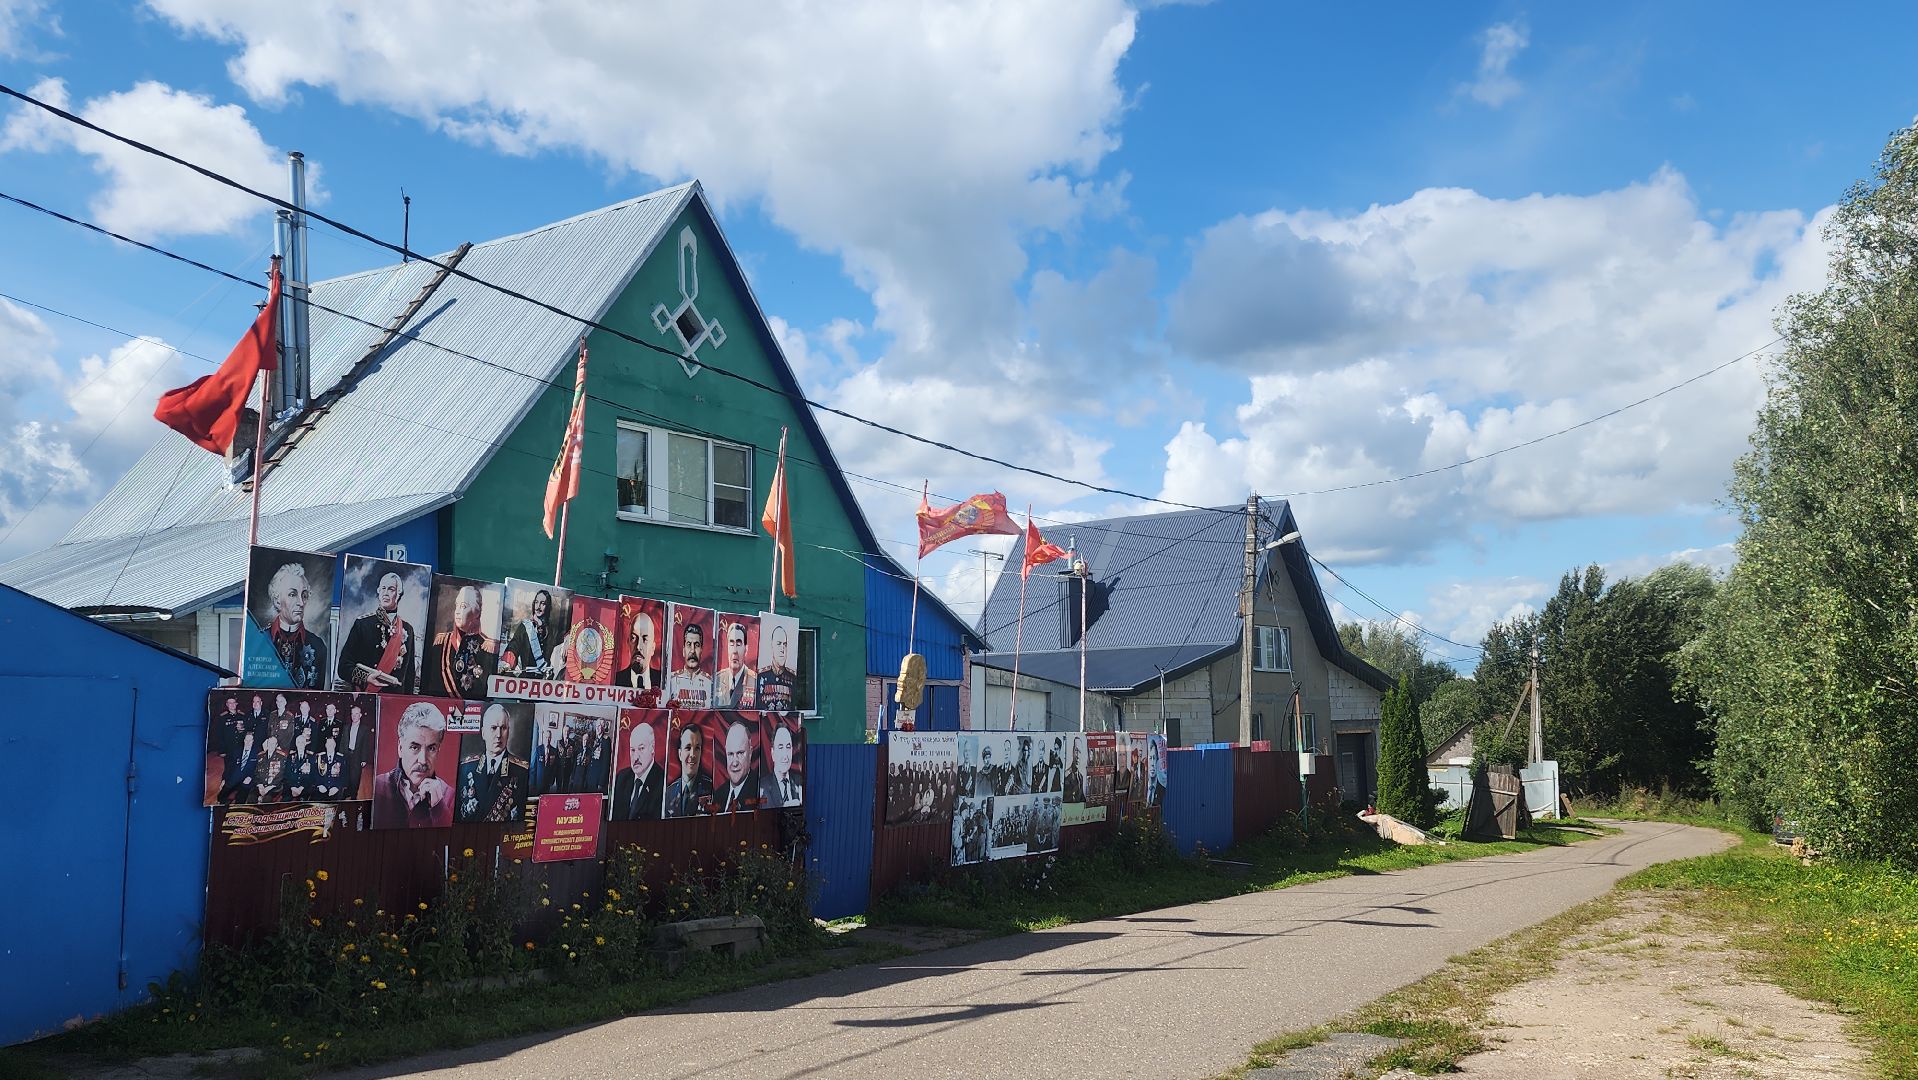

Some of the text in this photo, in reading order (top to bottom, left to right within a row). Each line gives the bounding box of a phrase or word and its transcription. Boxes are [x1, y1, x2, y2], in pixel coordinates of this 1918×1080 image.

[389, 549, 405, 562] 12
[494, 678, 663, 705] ГОРДОСТЬ ОТЧИЗН!
[556, 813, 584, 825] МУЗЕЙ
